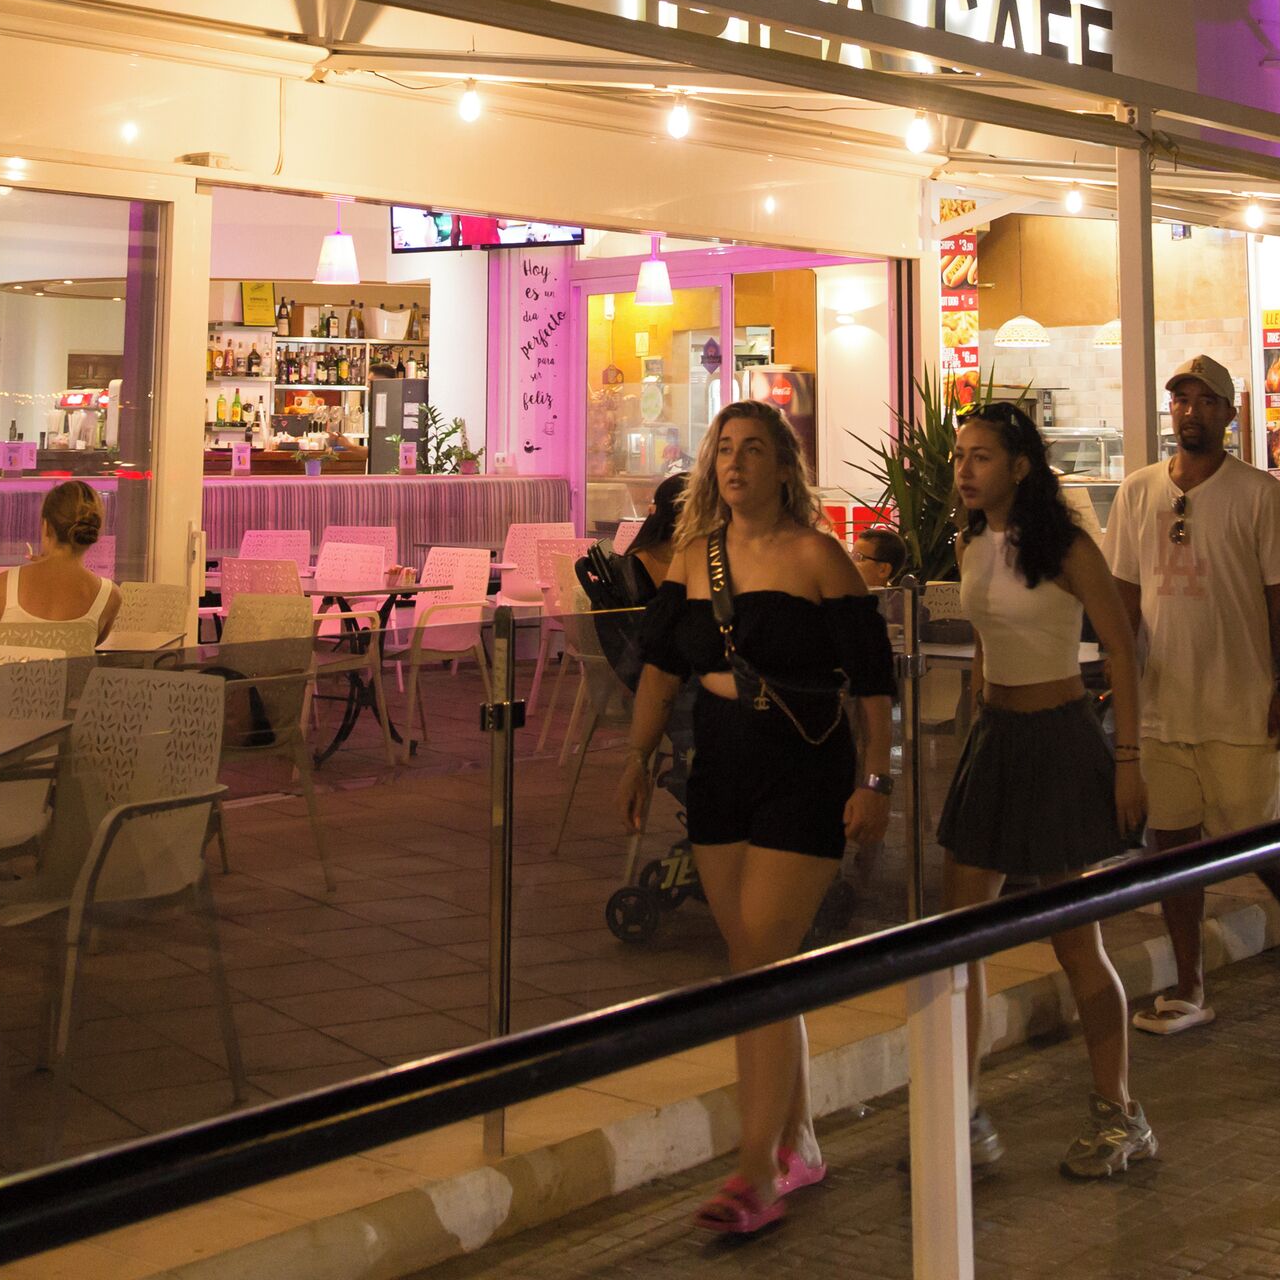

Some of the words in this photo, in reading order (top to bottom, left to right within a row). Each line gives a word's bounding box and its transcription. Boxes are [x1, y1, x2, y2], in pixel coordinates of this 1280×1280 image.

[523, 259, 550, 283] Hoy
[525, 287, 539, 301] es
[521, 311, 566, 360] perfecto
[537, 357, 555, 371] para
[523, 391, 553, 410] feliz
